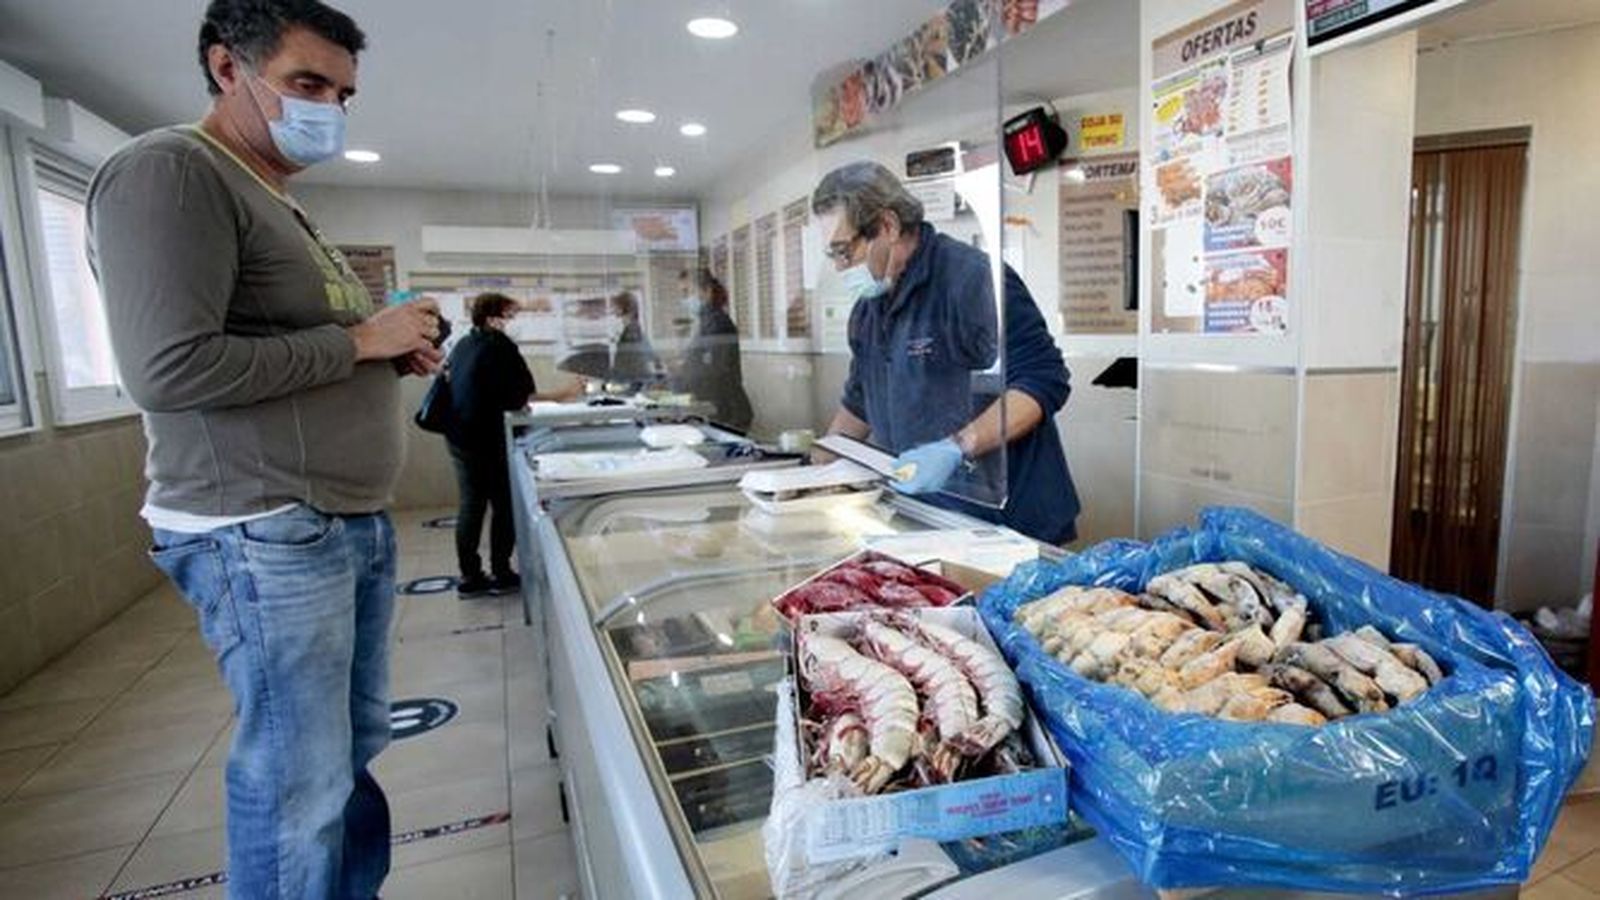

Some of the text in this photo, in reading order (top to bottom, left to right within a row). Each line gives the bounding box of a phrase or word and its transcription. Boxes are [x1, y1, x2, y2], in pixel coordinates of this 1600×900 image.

[1181, 11, 1257, 62] OFERTAS
[1018, 126, 1044, 162] 14
[1375, 773, 1439, 811] EU:
